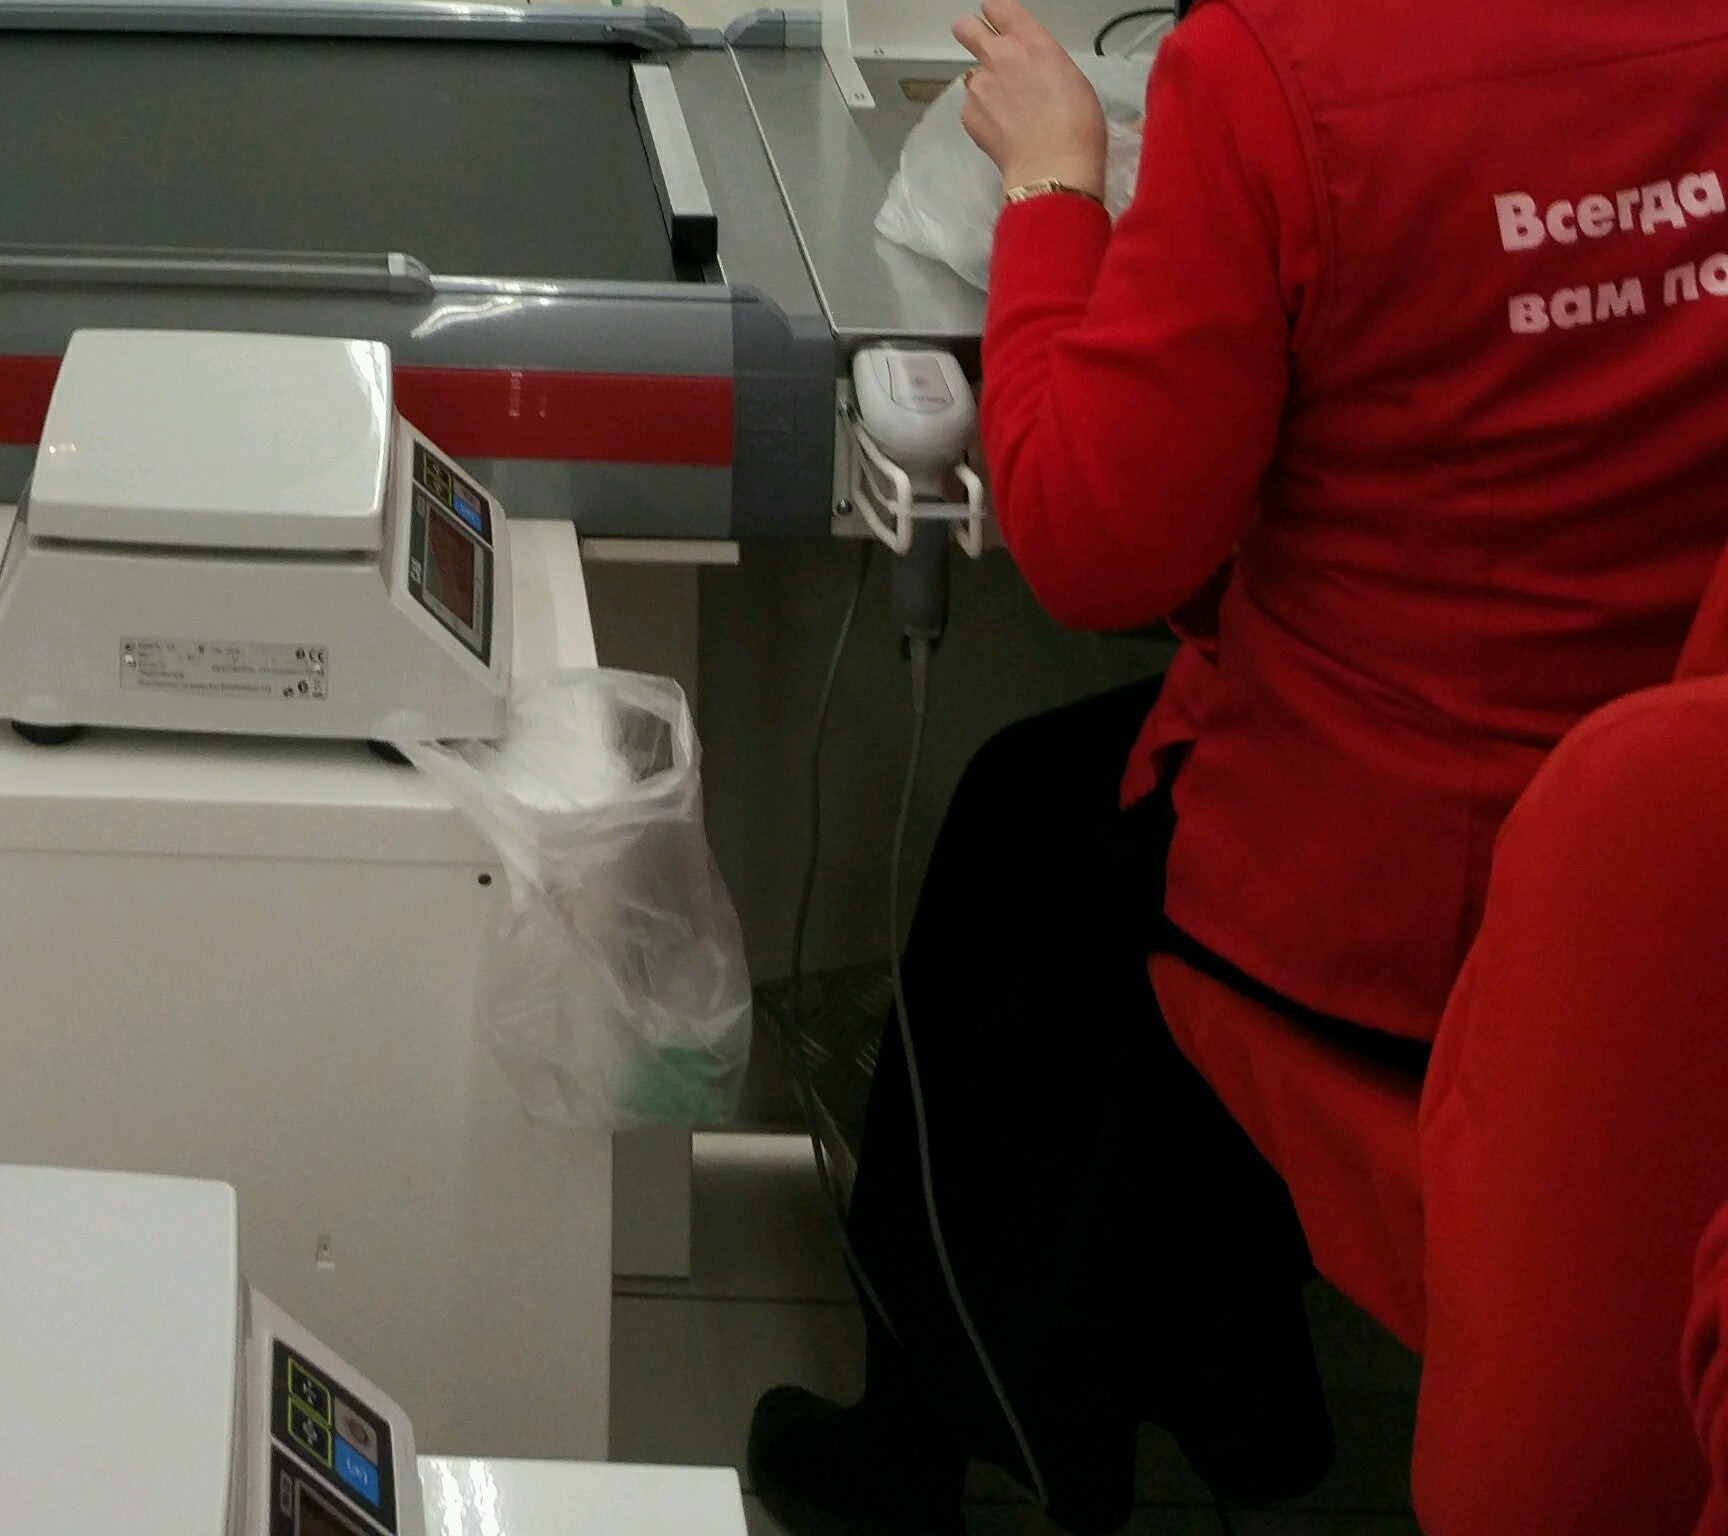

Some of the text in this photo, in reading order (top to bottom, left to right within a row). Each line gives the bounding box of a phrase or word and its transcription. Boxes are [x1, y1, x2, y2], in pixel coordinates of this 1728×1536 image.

[1493, 169, 1726, 253] Всегда
[1508, 253, 1728, 334] вам по
